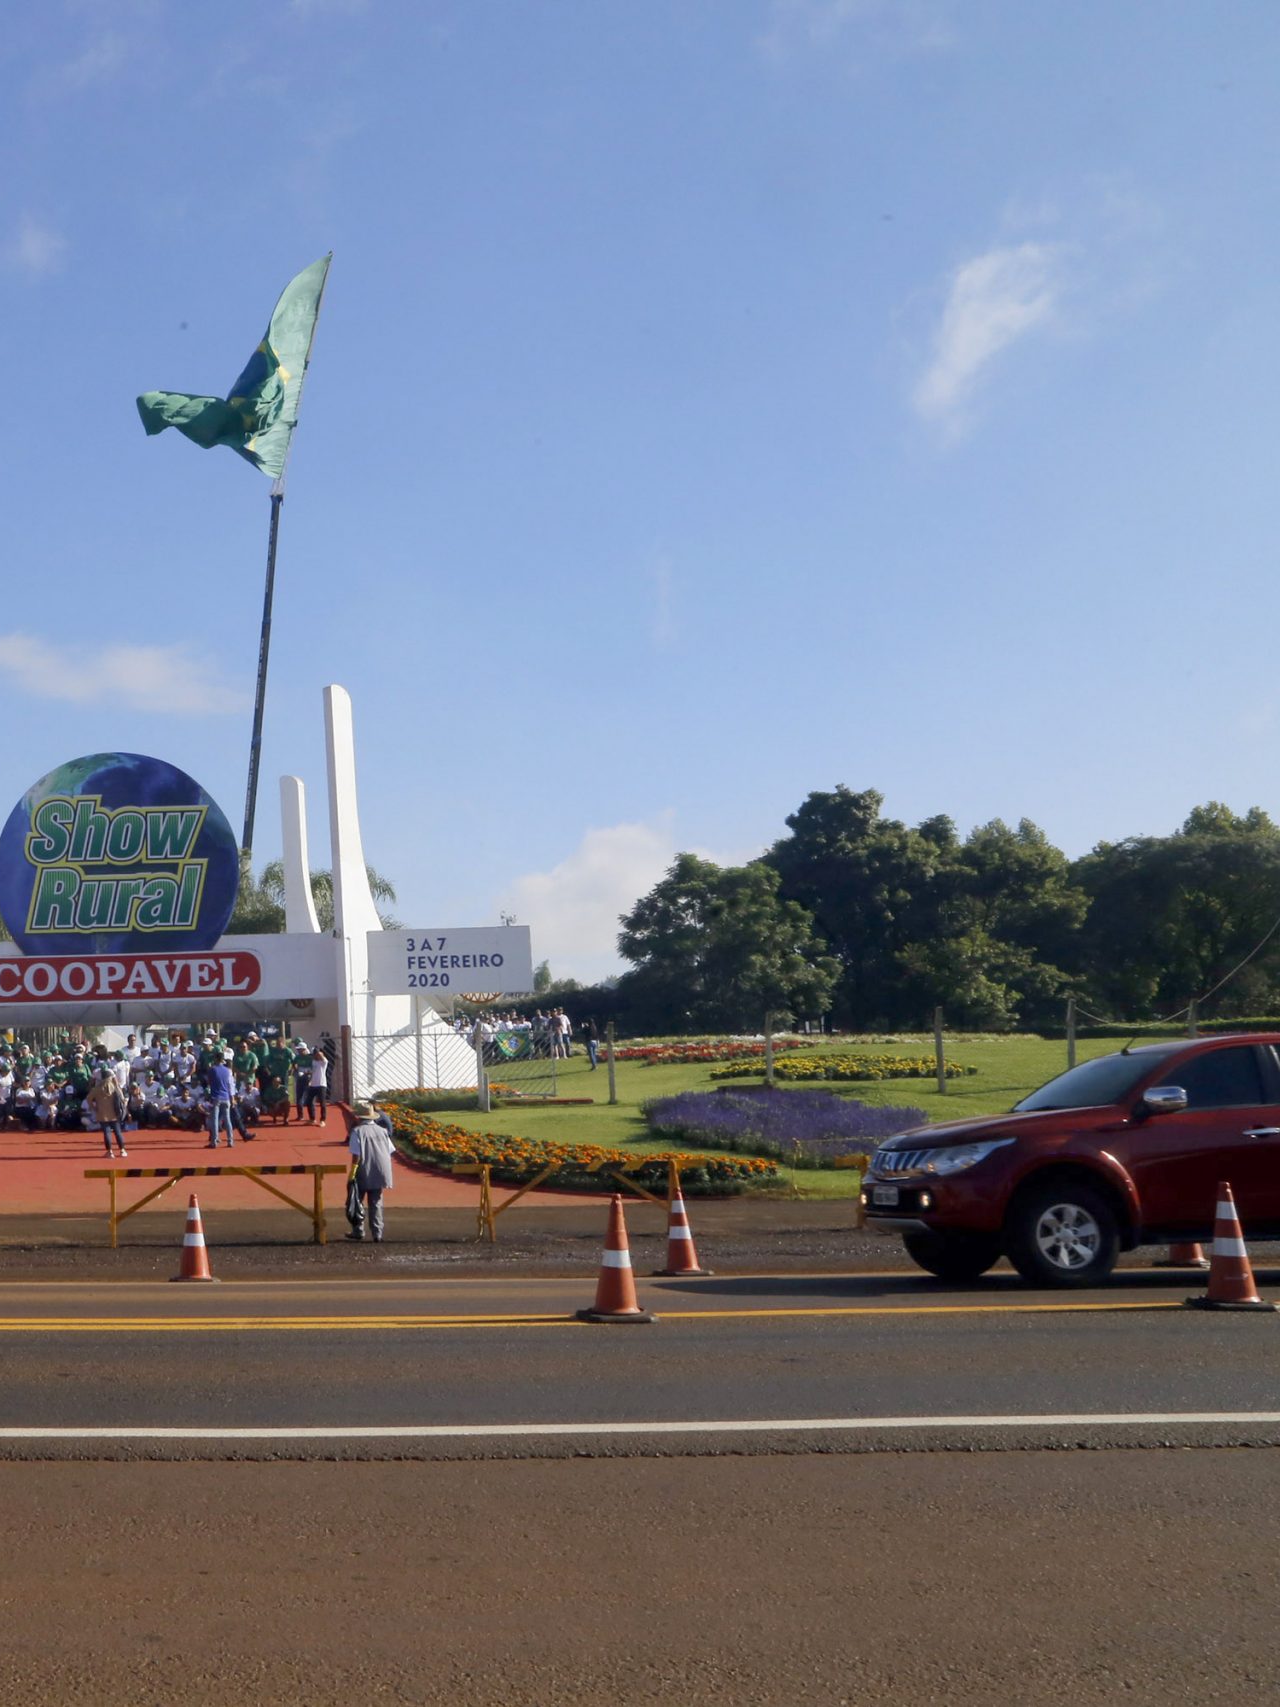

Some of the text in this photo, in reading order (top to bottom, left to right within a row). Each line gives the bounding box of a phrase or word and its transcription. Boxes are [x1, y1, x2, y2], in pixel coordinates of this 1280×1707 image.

[27, 798, 204, 864] Show
[29, 864, 204, 930] Rural
[407, 938, 446, 951] 3 A 7
[407, 953, 504, 970] FEVEREIRO
[408, 973, 450, 987] 2020
